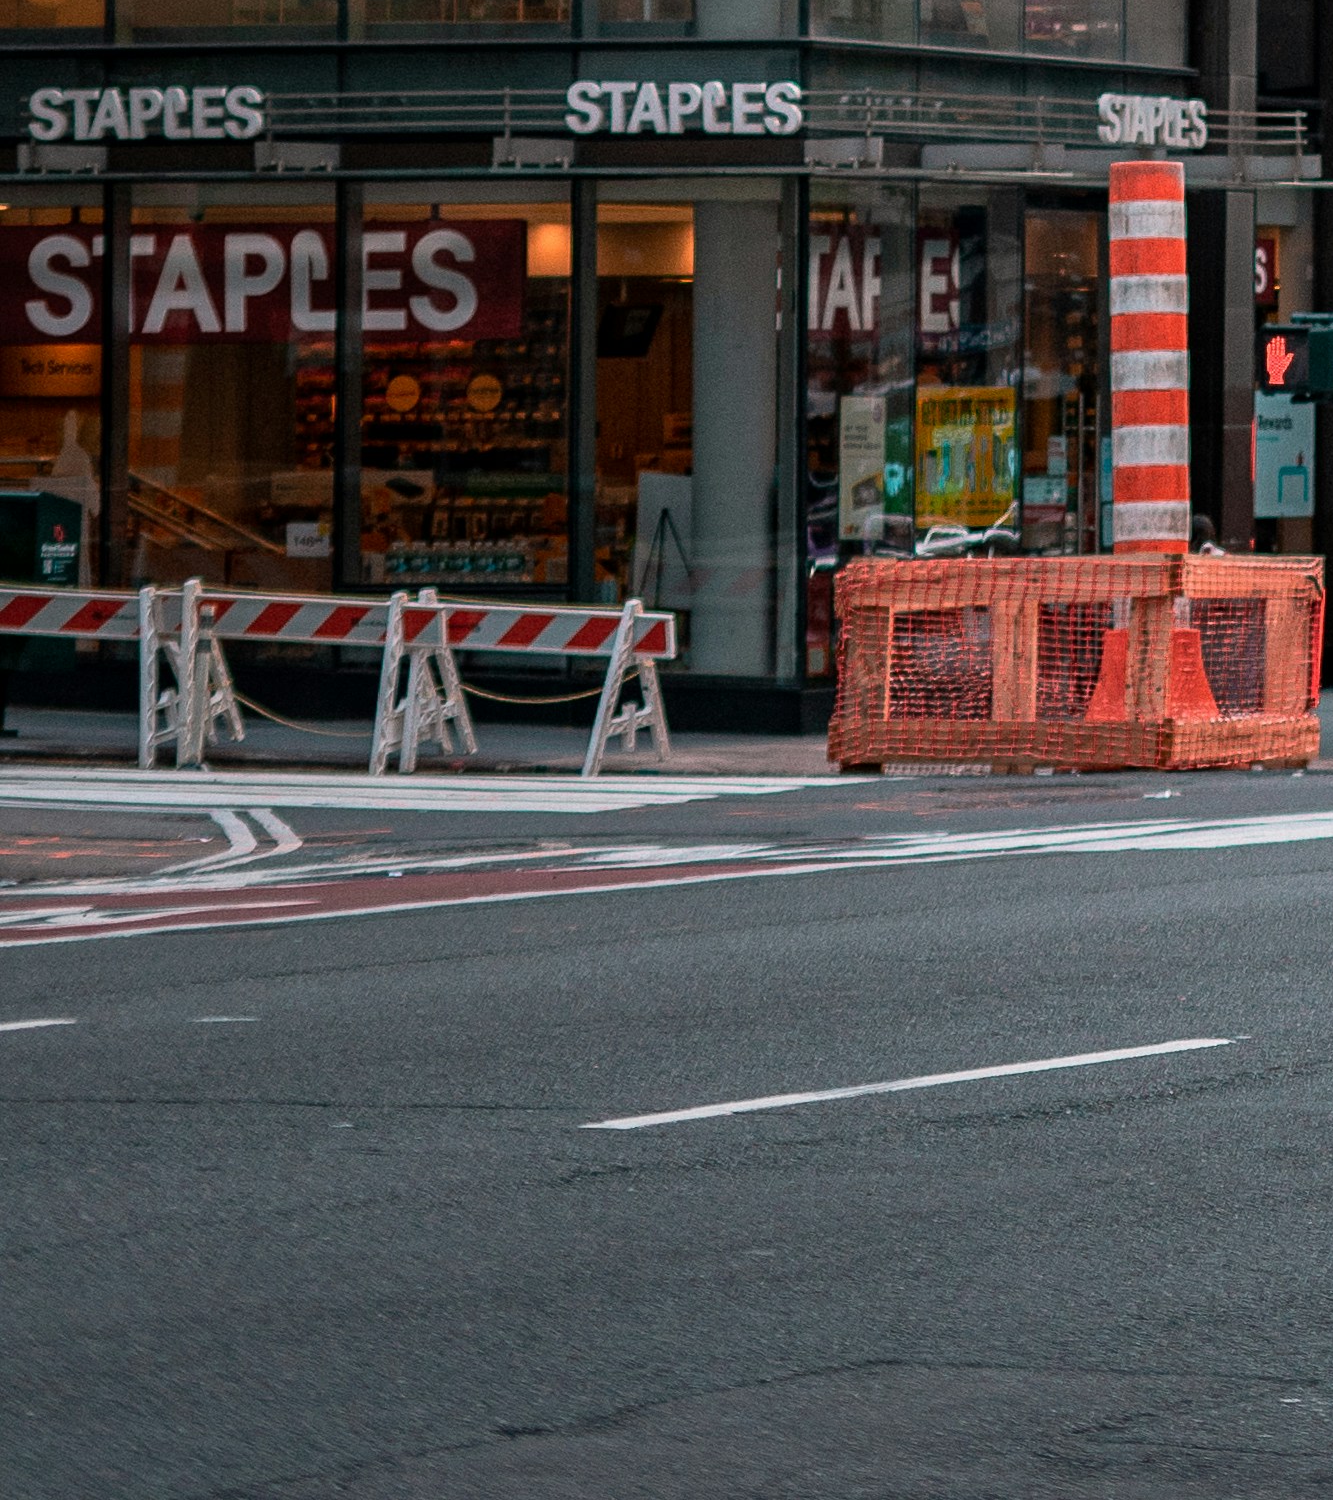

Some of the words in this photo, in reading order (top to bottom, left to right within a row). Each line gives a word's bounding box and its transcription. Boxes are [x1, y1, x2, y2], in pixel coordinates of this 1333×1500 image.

[28, 85, 266, 141] STAPLES
[565, 80, 803, 135] STAPLES
[1097, 92, 1207, 150] STAPLES
[24, 228, 479, 337] STAPLES
